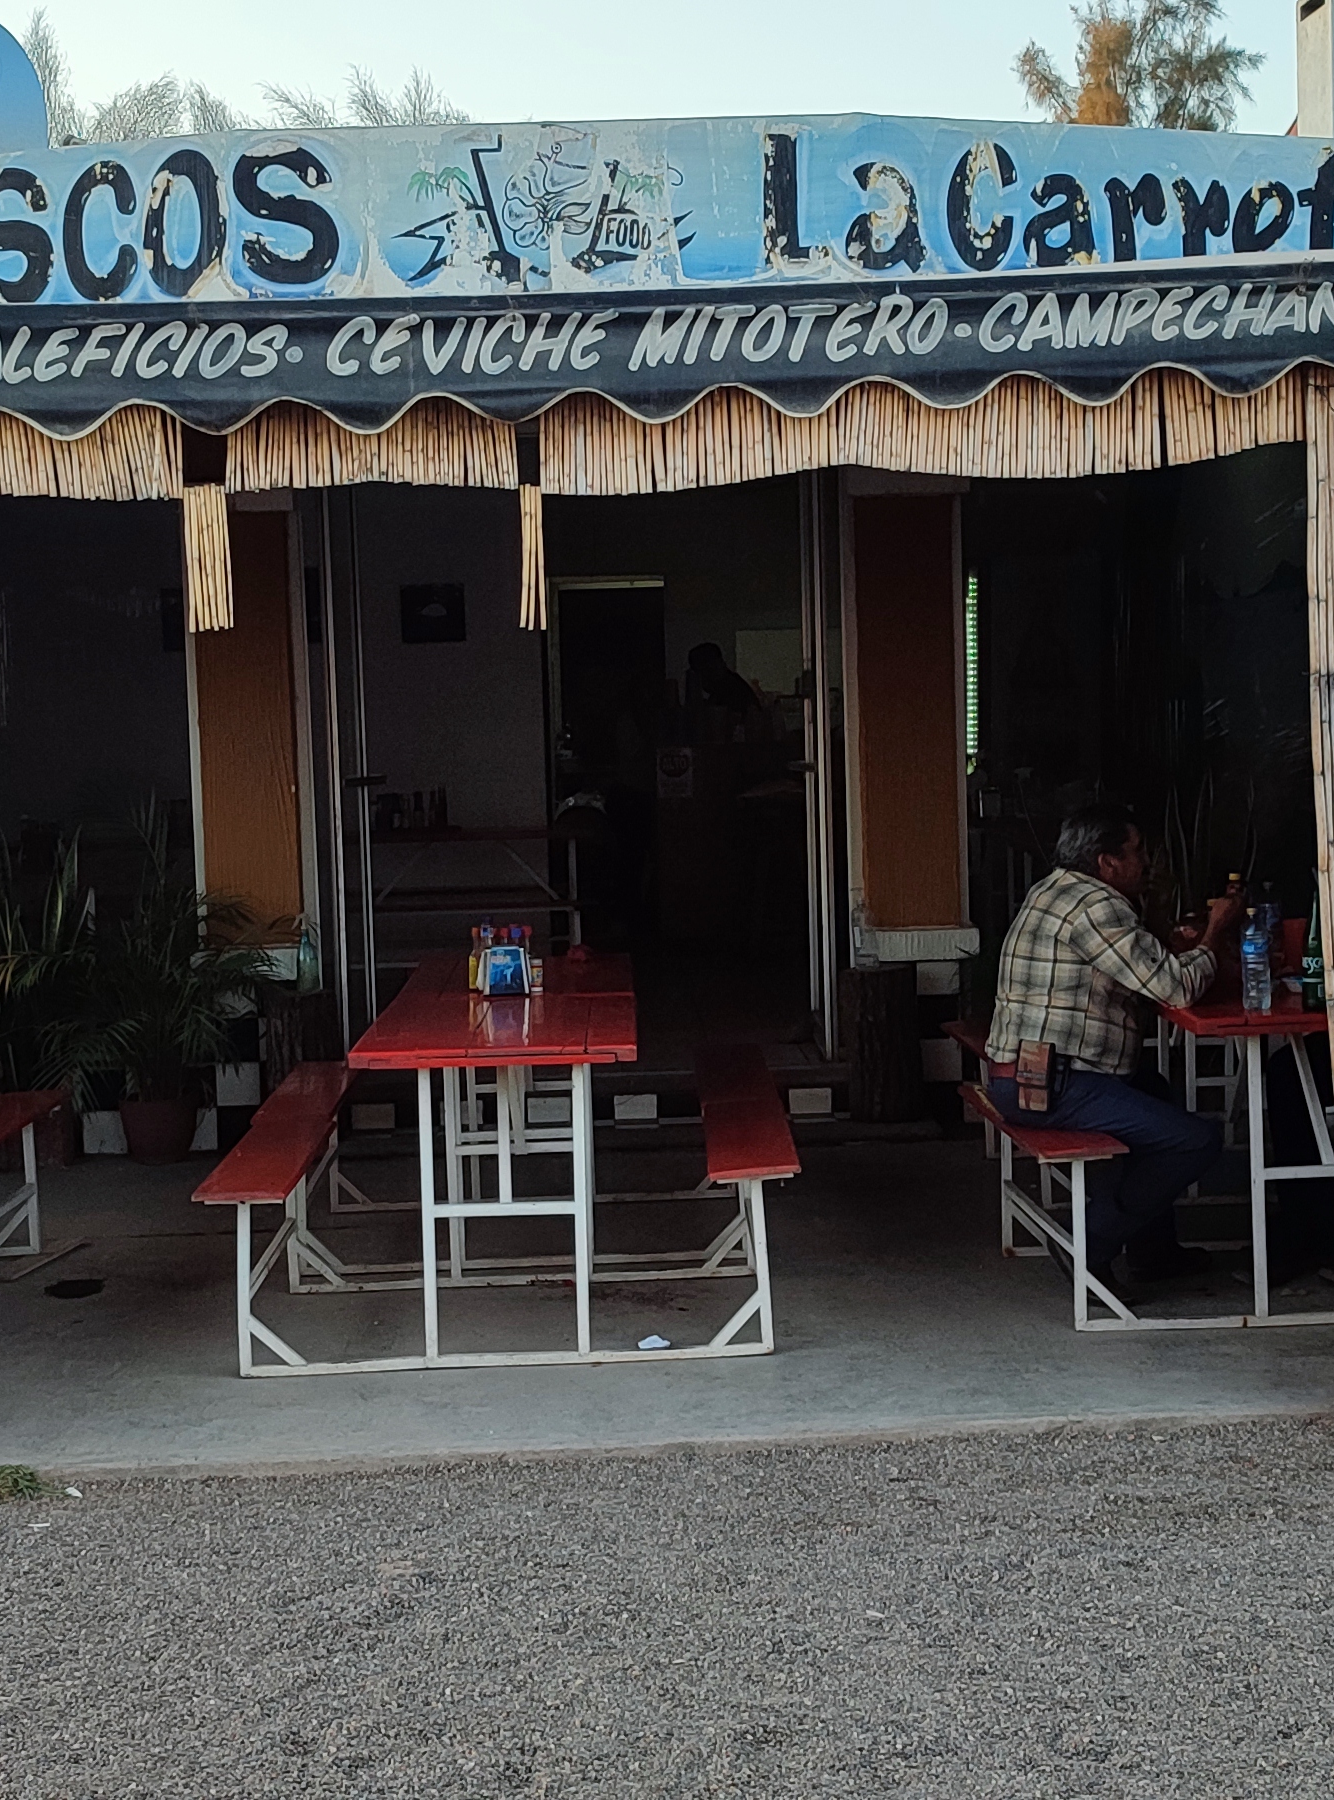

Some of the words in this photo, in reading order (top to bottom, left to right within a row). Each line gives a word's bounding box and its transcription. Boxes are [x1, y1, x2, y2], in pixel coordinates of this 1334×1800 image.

[605, 217, 653, 251] FOOD
[325, 308, 620, 377] CEVICHE
[627, 293, 950, 372] MITOTERO
